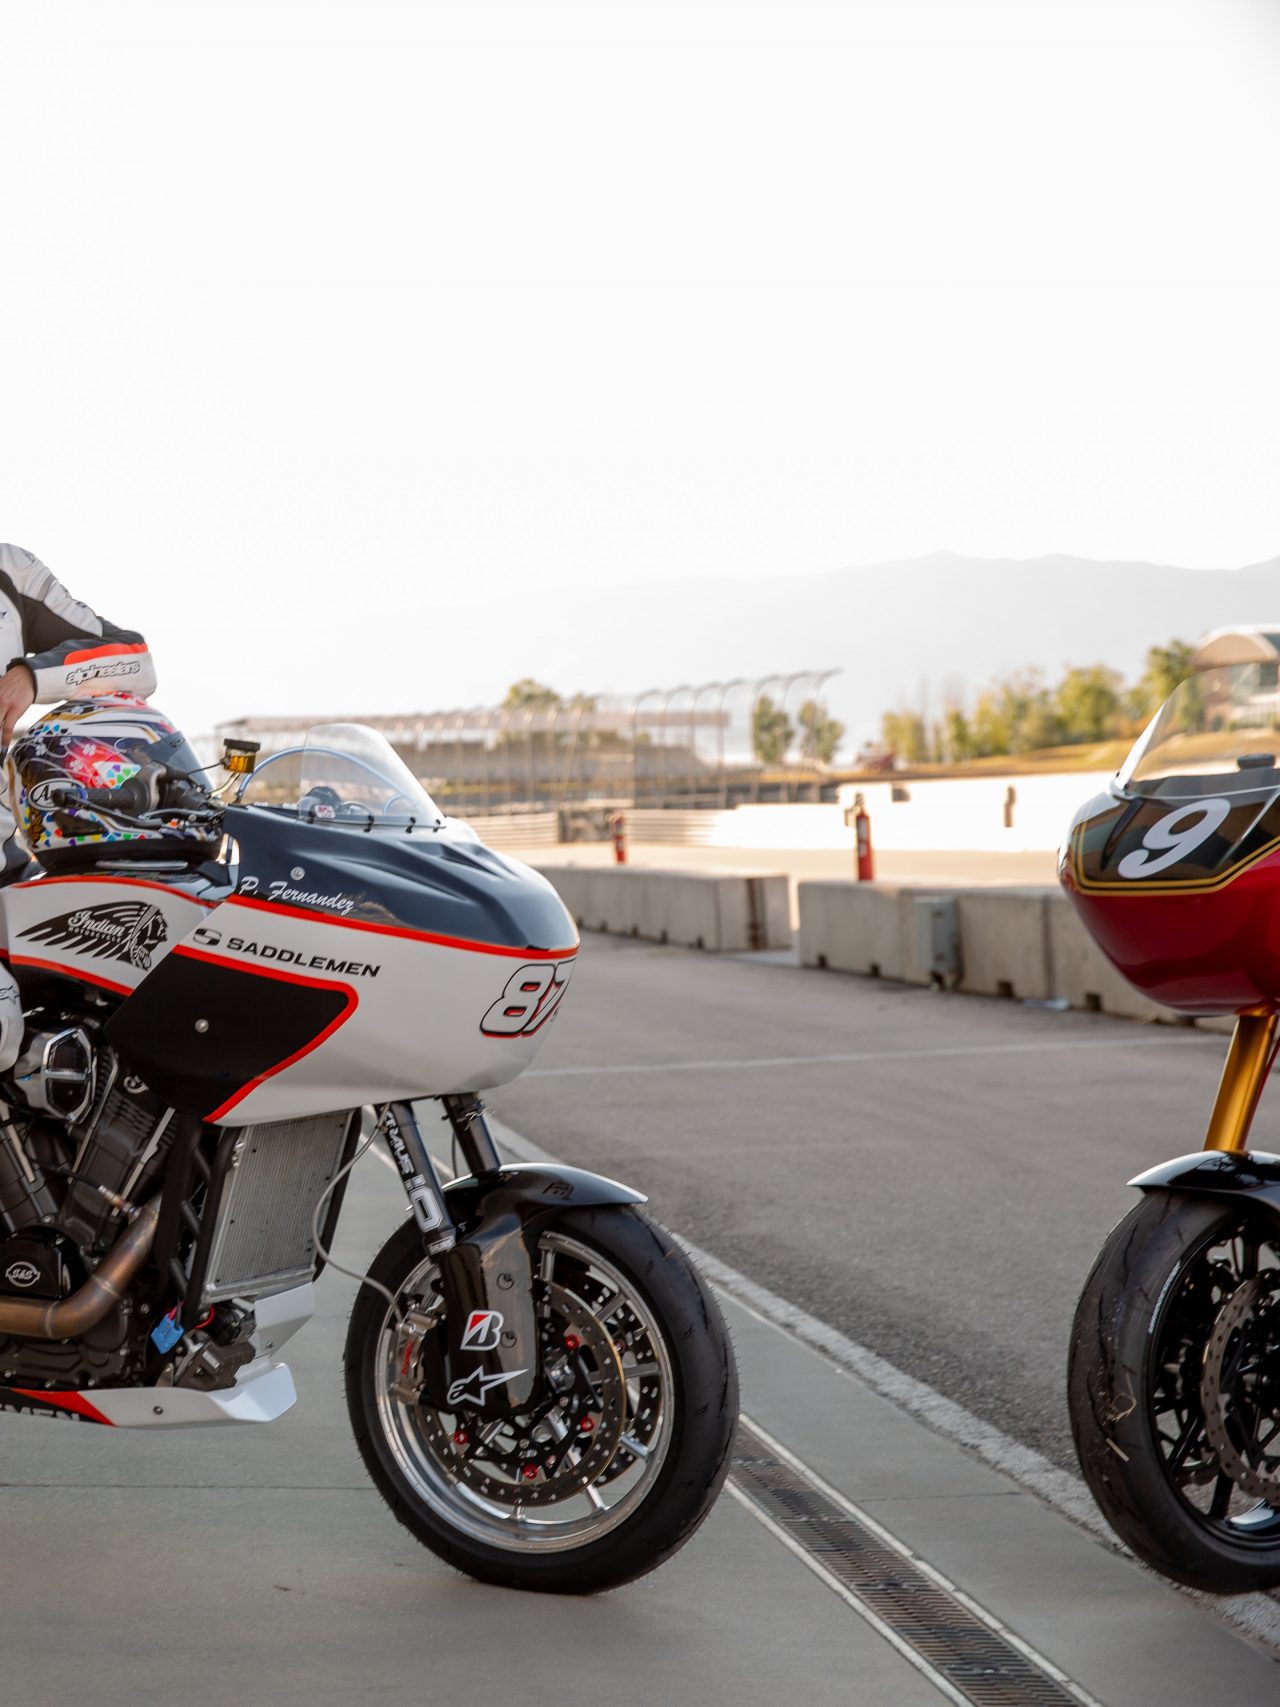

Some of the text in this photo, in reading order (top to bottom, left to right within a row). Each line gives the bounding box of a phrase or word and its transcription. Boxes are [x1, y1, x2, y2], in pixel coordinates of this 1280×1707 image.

[65, 661, 141, 686] alpinestars
[1117, 797, 1232, 880] 9
[238, 875, 356, 916] P. Fernandez
[67, 909, 127, 937] Indian
[67, 925, 122, 943] MOTORCYCLE
[226, 936, 382, 978] SADDLEMEN
[479, 957, 577, 1039] 87
